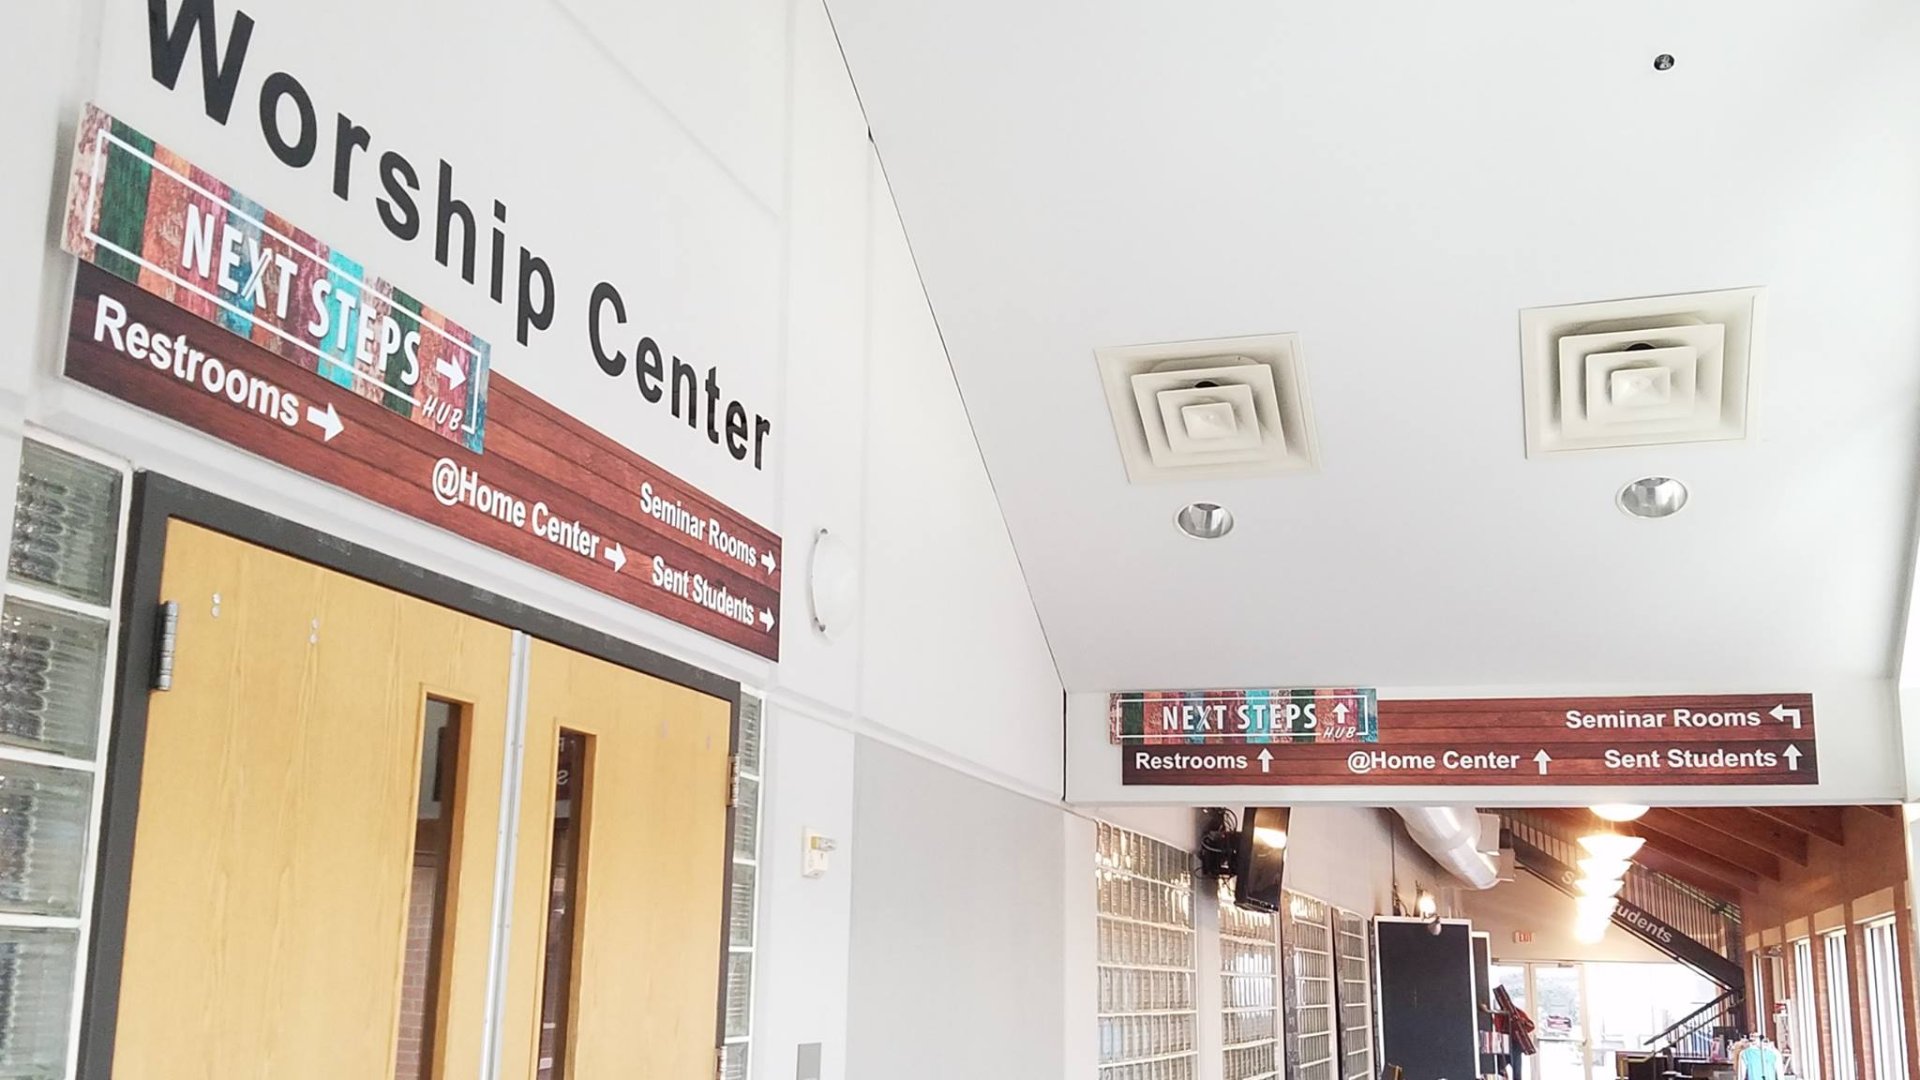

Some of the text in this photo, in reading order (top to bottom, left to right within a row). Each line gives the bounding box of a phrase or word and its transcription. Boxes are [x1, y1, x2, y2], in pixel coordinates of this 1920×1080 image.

[147, 0, 770, 470] Worship Center
[181, 203, 421, 385] NEXT STEPS
[94, 295, 299, 427] Restrooms
[422, 396, 464, 431] HUB
[432, 458, 599, 559] @Home Center
[640, 482, 756, 568] Seminar Rooms
[652, 555, 754, 626] Sent Students
[1163, 703, 1317, 731] NEXT STEPS
[1323, 726, 1356, 739] HUB
[1566, 709, 1761, 729] Seminar Rooms
[1135, 752, 1248, 770] Restrooms
[1347, 750, 1520, 774] @Home Center
[1604, 747, 1777, 769] Sent Students
[1614, 903, 1673, 943] udents
